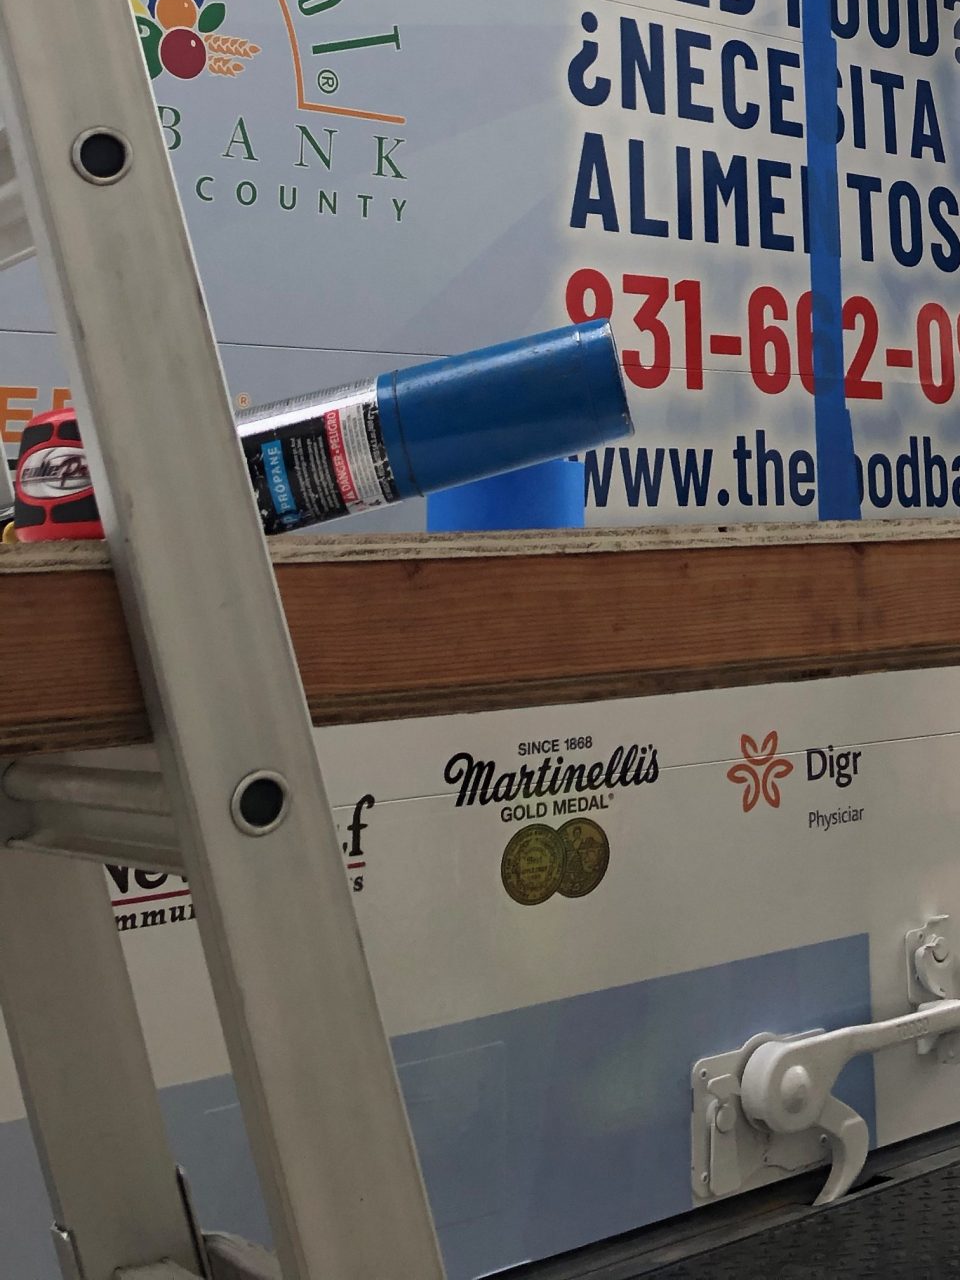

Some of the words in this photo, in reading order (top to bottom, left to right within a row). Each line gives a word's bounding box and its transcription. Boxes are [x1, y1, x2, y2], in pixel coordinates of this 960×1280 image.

[567, 10, 947, 164] ¿NECEITA
[157, 105, 408, 180] BANK
[195, 176, 408, 222] COUNTY
[267, 446, 292, 510] PROPANE
[444, 743, 660, 807] Martinelli's
[517, 738, 560, 756] SINCE
[564, 736, 593, 752] 1868
[500, 802, 548, 823] GOLD
